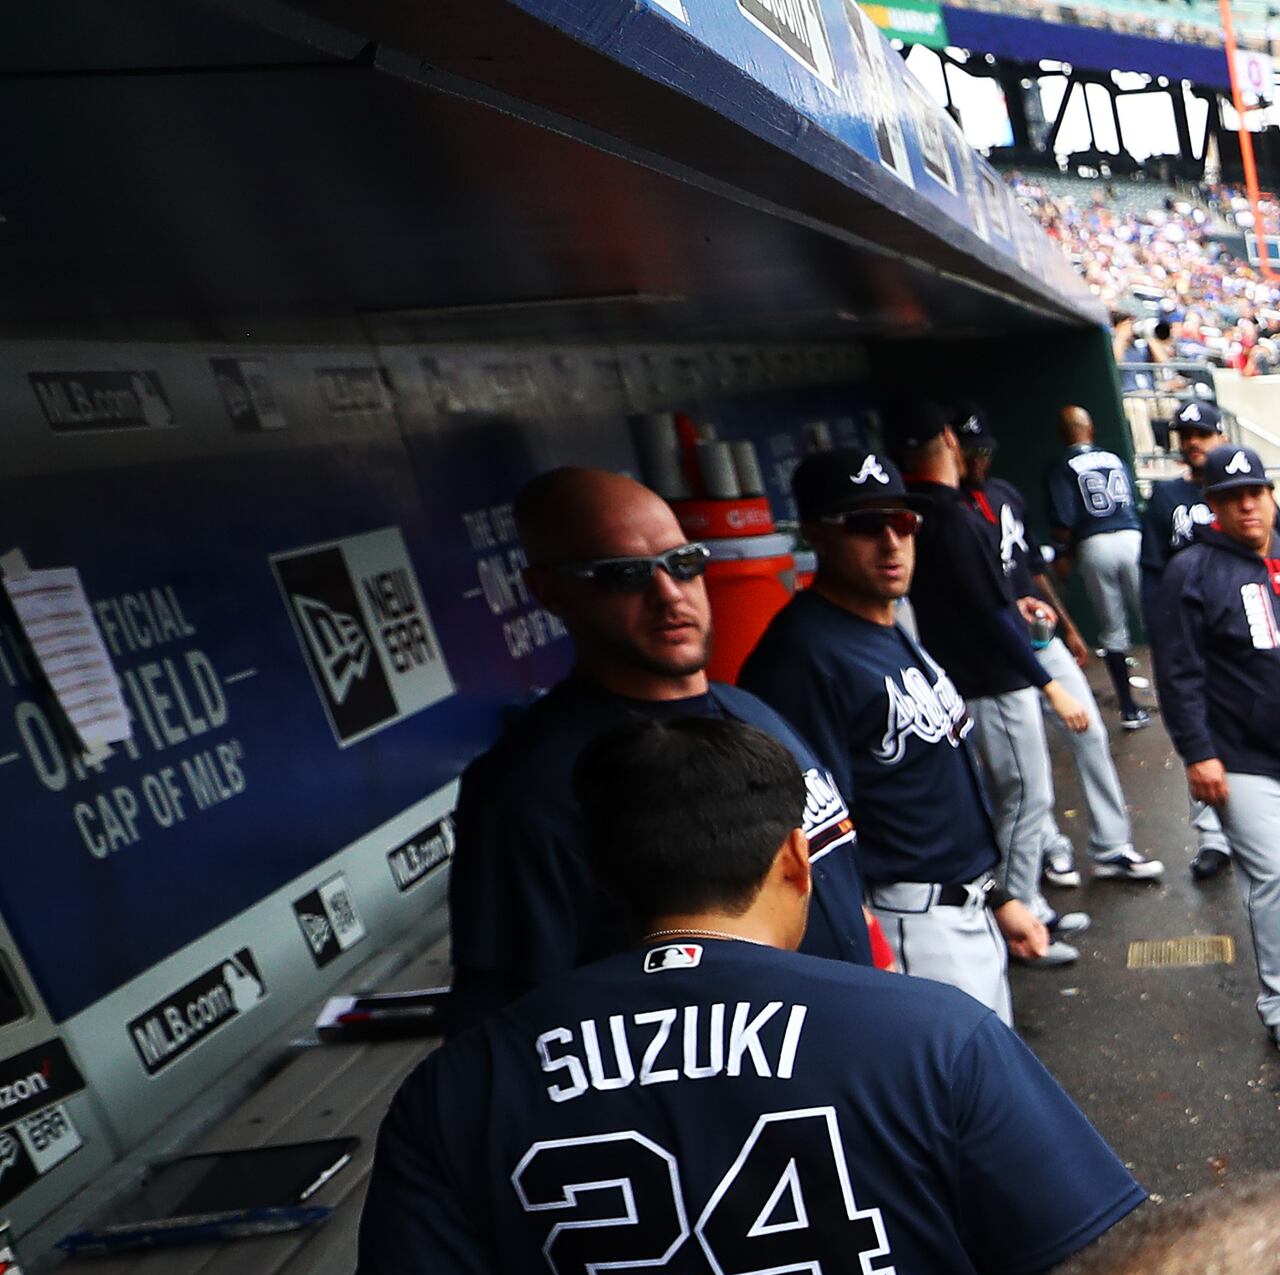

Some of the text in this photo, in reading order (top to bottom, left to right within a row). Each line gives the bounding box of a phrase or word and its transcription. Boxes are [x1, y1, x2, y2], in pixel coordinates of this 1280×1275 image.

[360, 567, 418, 621] NEW
[381, 615, 437, 674] ERA
[72, 785, 142, 860] CAP
[141, 765, 187, 828] OF
[133, 983, 234, 1068] MLB.com
[534, 1001, 808, 1103] SUZUKI
